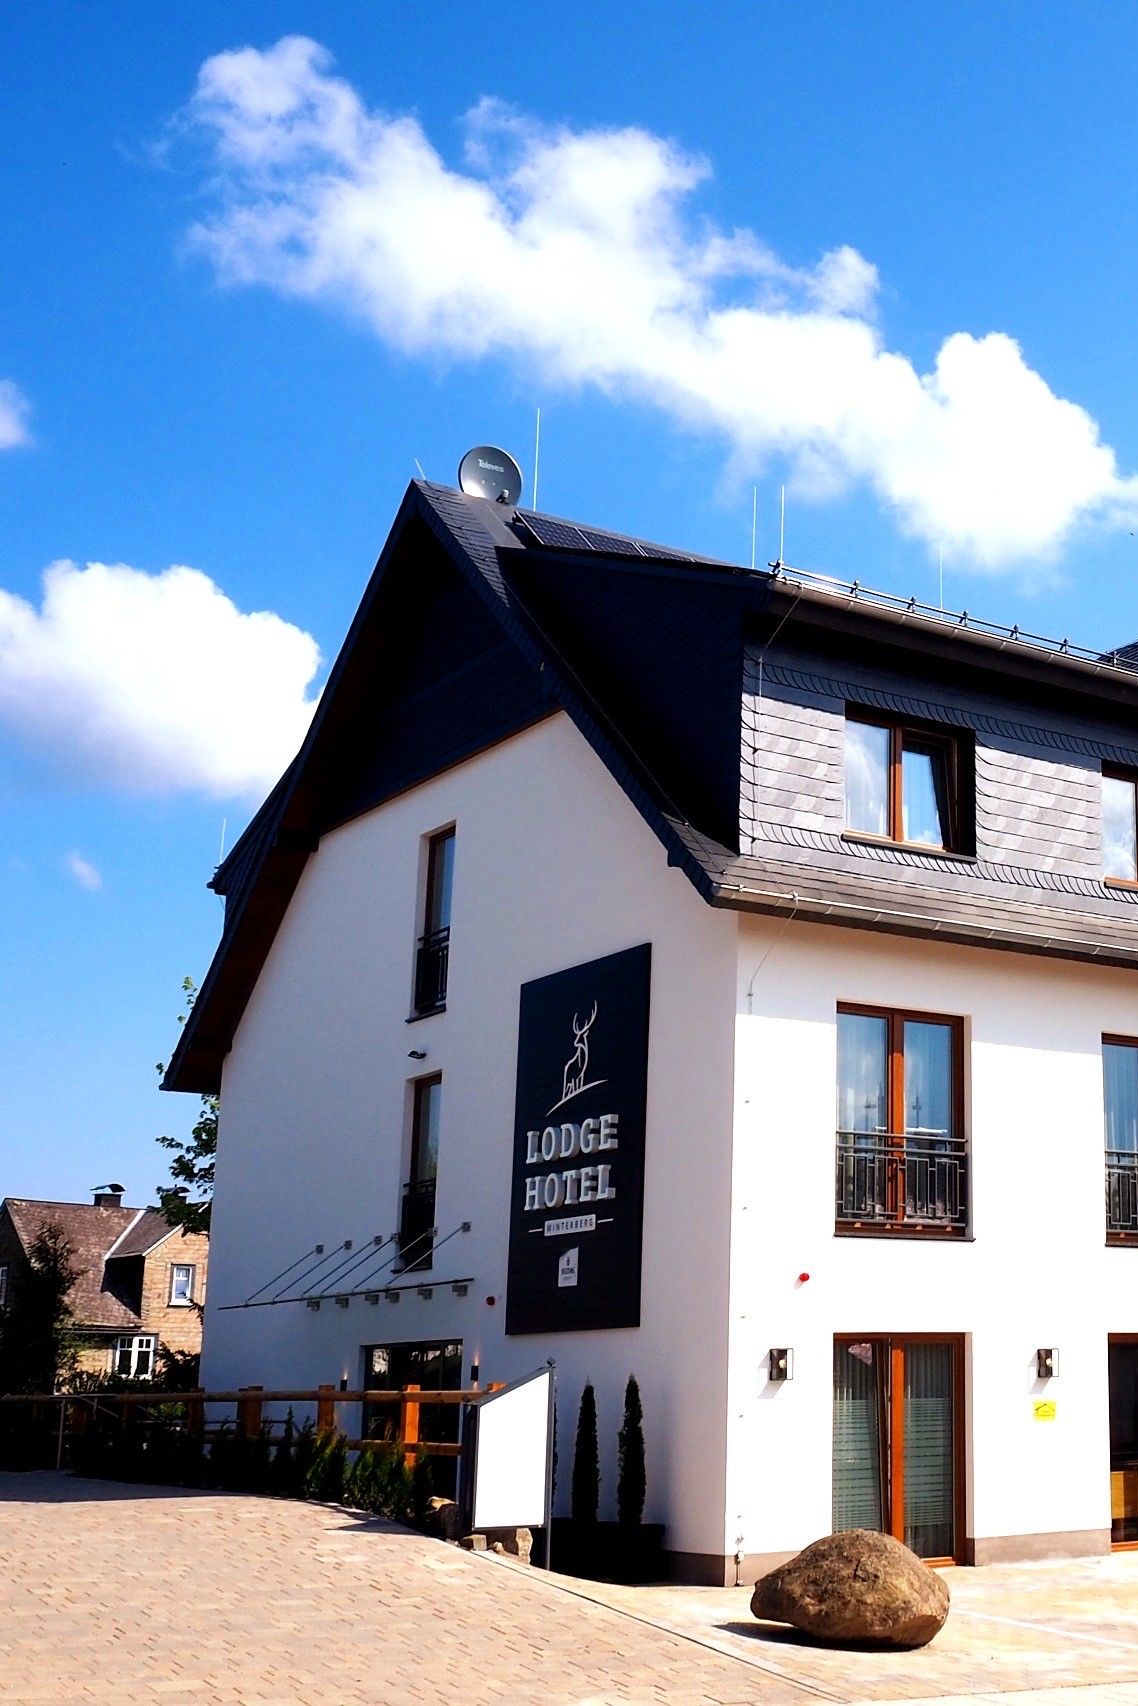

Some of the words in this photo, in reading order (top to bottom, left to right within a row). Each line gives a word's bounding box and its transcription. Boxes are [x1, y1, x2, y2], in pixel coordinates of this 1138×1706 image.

[525, 1113, 618, 1164] LODGE
[524, 1164, 616, 1211] HOTEL
[546, 1217, 594, 1233] WINTERBERG
